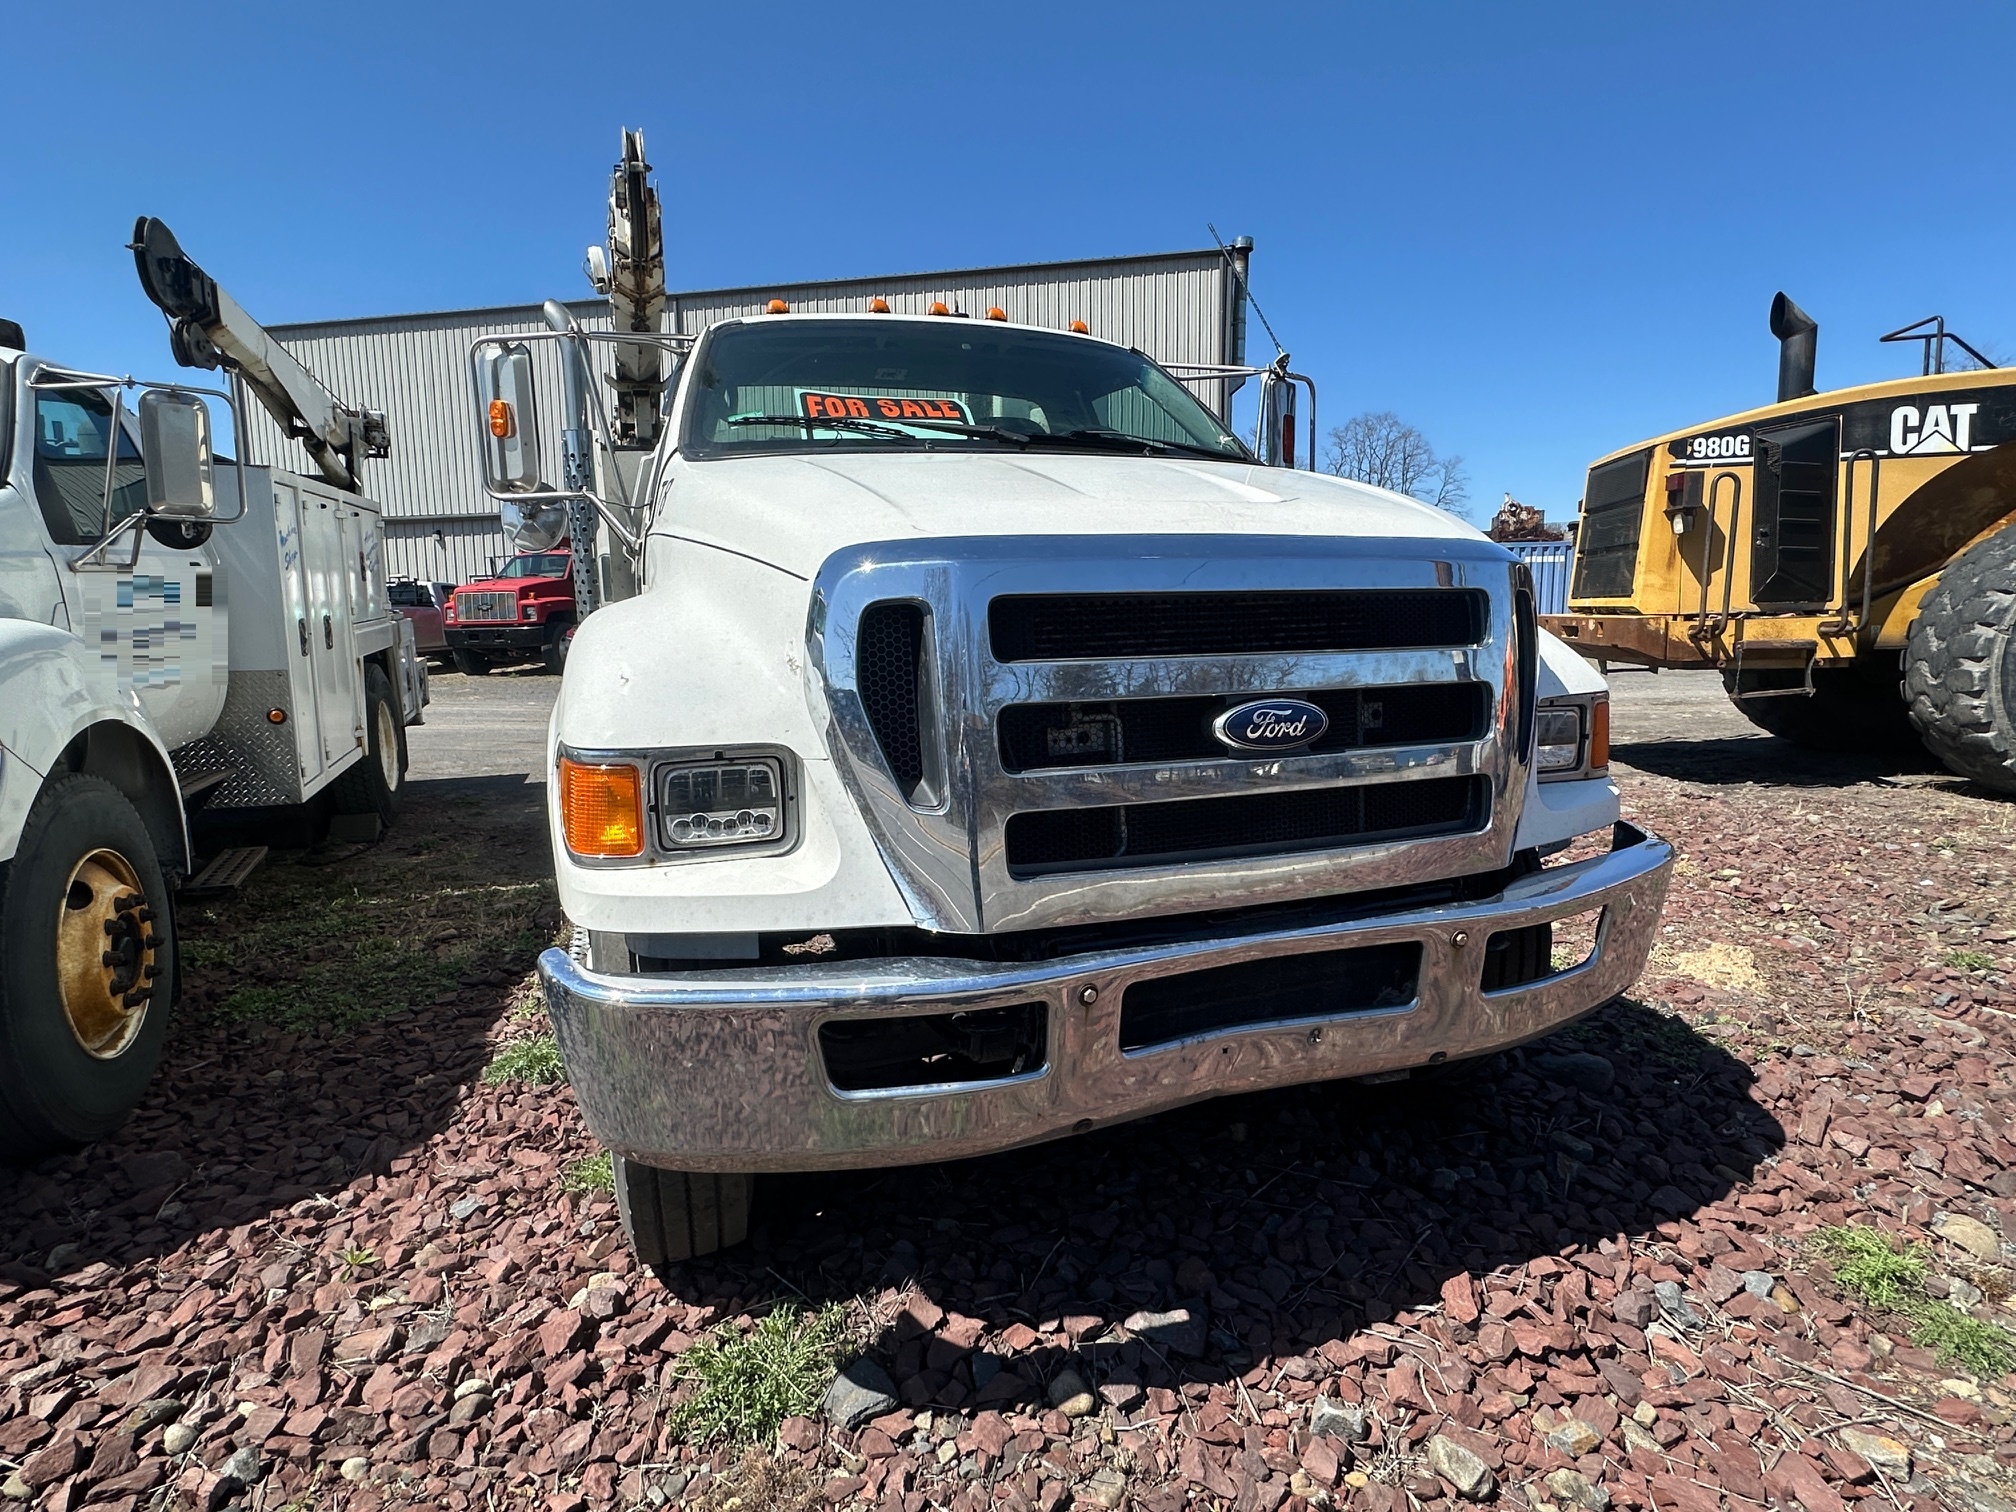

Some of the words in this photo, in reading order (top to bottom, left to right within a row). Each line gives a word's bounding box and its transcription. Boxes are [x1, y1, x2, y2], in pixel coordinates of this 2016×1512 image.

[806, 395, 870, 418] FOR
[876, 398, 961, 418] SALE
[1889, 403, 1980, 453] CAT
[1692, 434, 1750, 459] 980G
[1246, 709, 1308, 739] Ford
